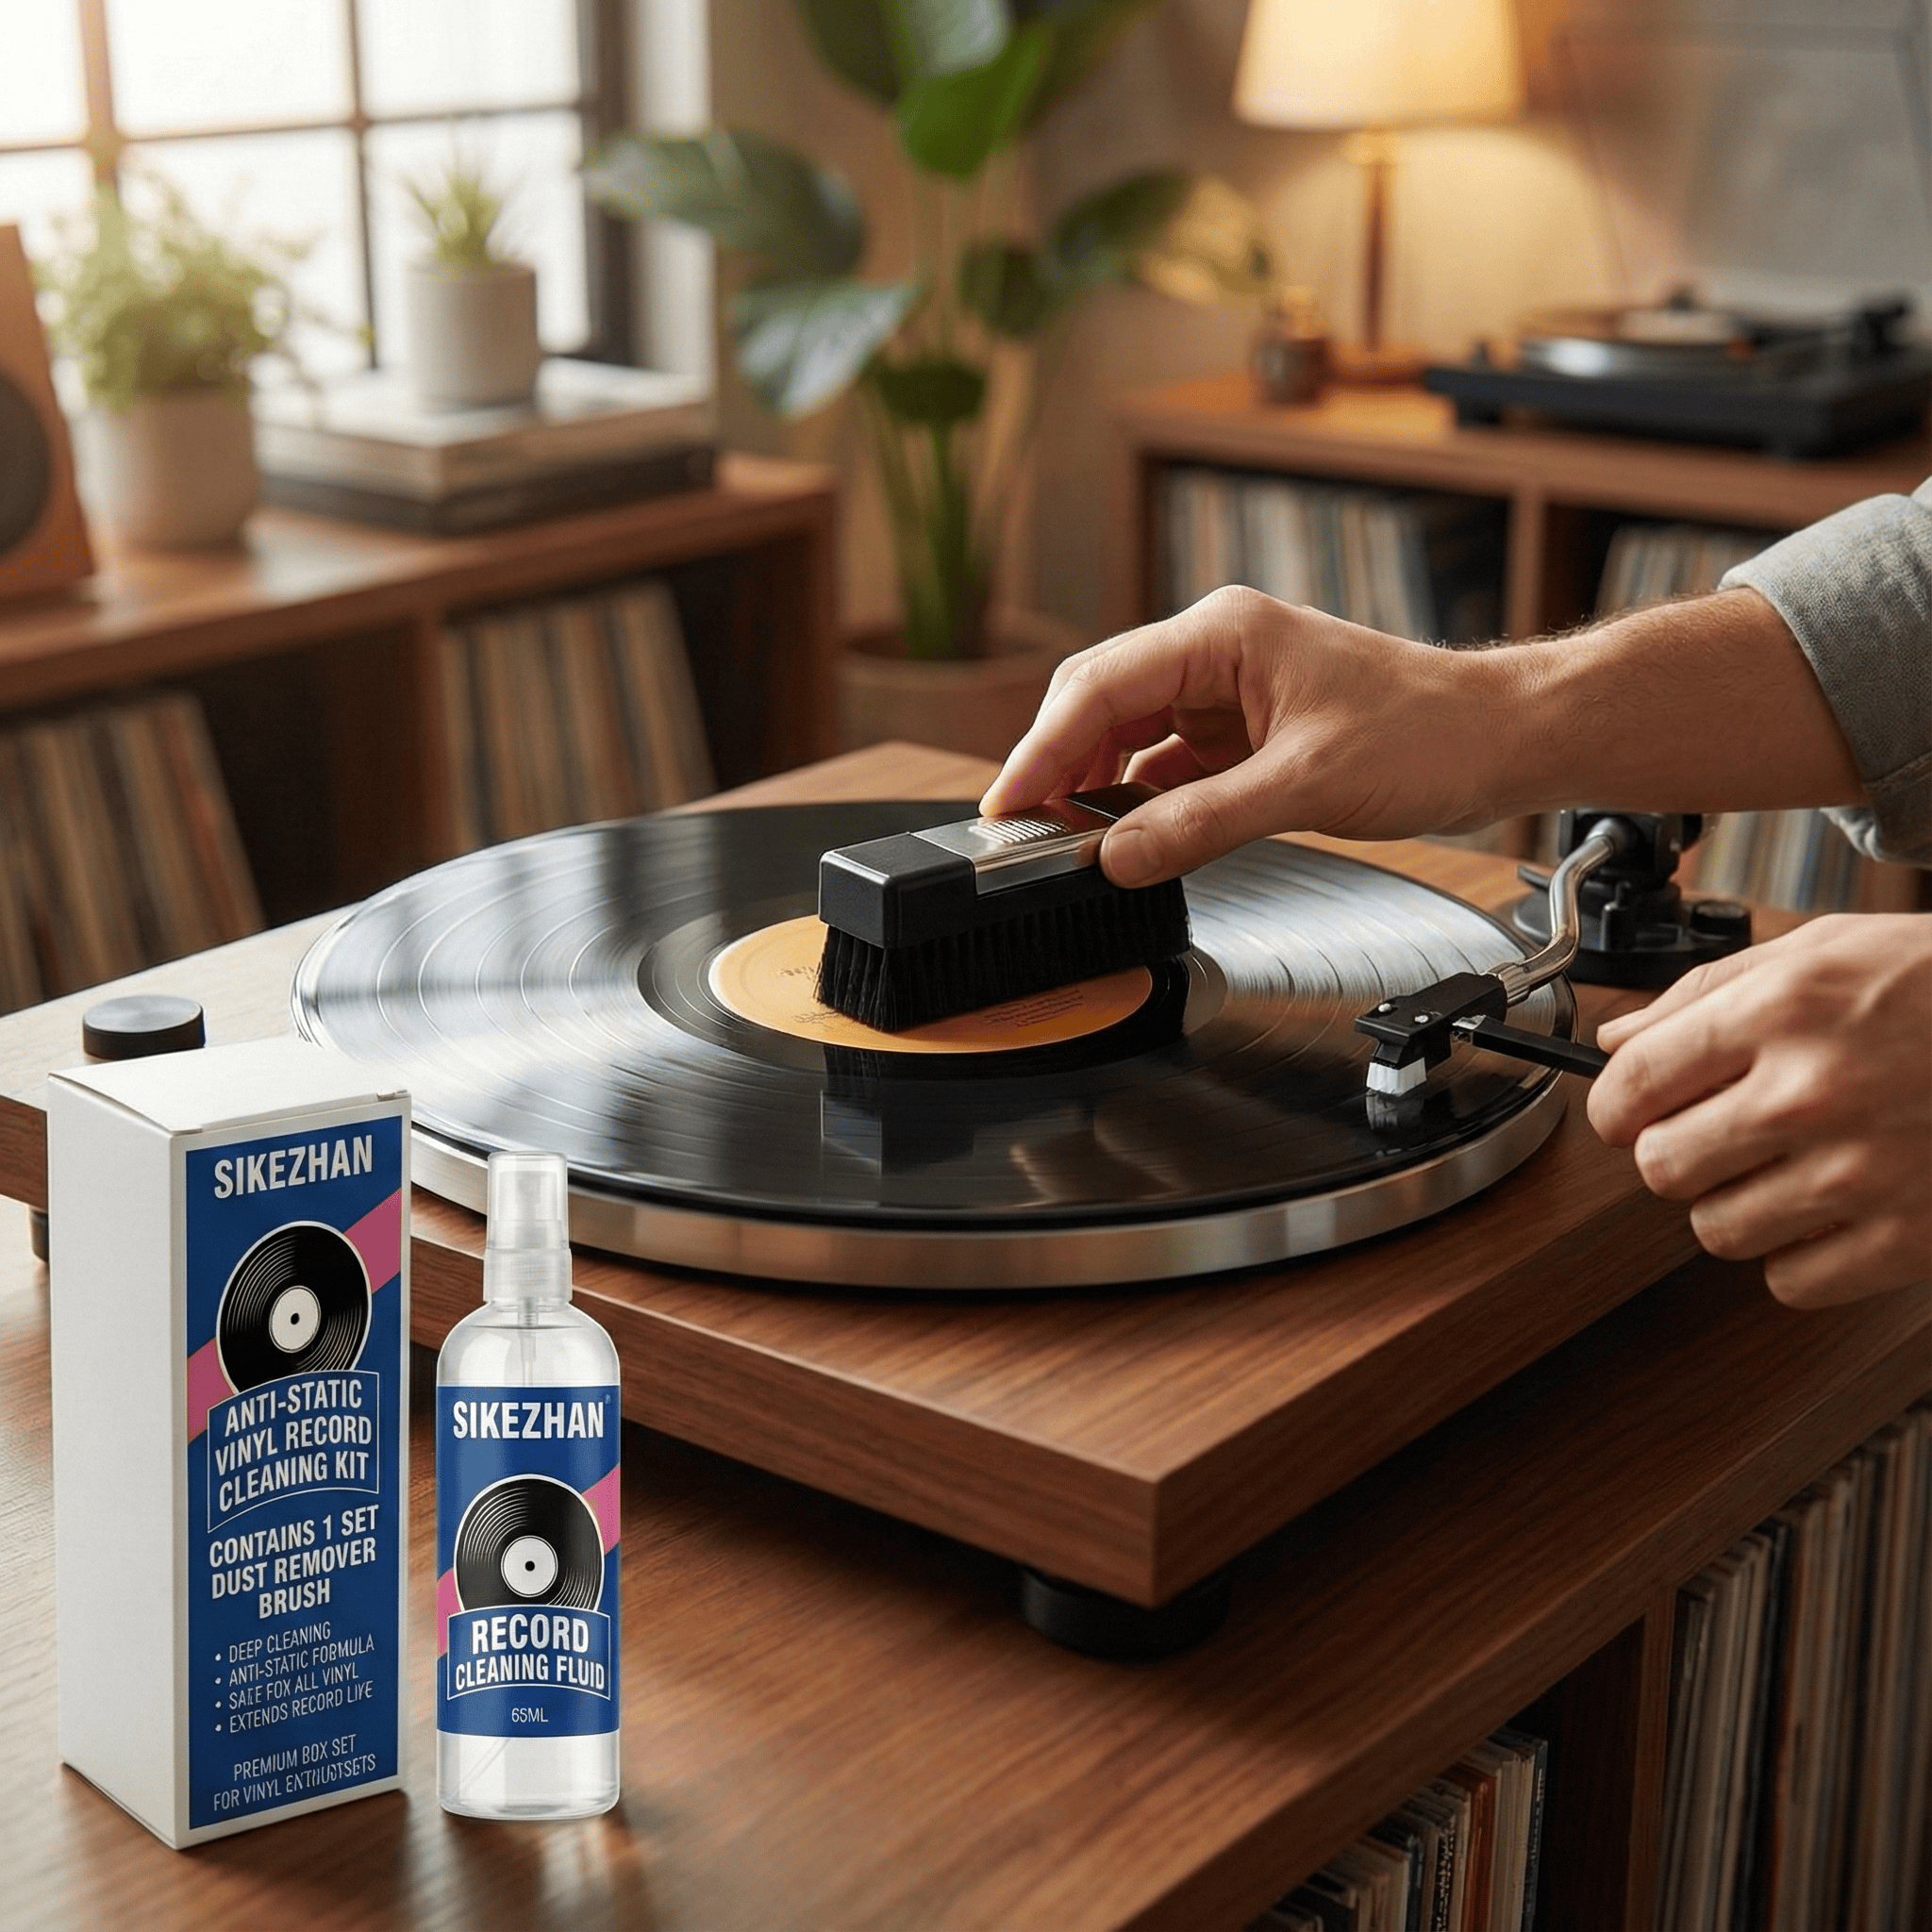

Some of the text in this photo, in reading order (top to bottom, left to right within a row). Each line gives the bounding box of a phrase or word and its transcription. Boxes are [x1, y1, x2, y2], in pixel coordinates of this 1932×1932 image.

[214, 1135, 372, 1199] SIKEZHAN
[225, 1379, 362, 1437] ANTI-STATIC
[453, 1401, 604, 1439] SIKEZHAN
[215, 1415, 372, 1476] VINYL RECORD
[219, 1451, 369, 1511] CLEANING KIT
[209, 1505, 379, 1568] CONTAINS 1 SET
[212, 1537, 375, 1599] DUST REMOVER
[259, 1577, 330, 1619] BRUSH
[229, 1621, 330, 1663] DEEP CLEANING
[472, 1613, 589, 1655] RECORD
[229, 1650, 308, 1687] ANTI-STATIC
[266, 1679, 291, 1701] FOX
[294, 1672, 319, 1693] ALL
[323, 1661, 358, 1687] VINYL
[456, 1654, 605, 1690] CLEANING FLUID
[229, 1702, 288, 1733] EXTENDS
[291, 1689, 342, 1718] RECORD
[234, 1734, 357, 1781] PREMIUM BOX SET
[214, 1789, 240, 1811] FOR
[243, 1779, 282, 1805] VINYL
